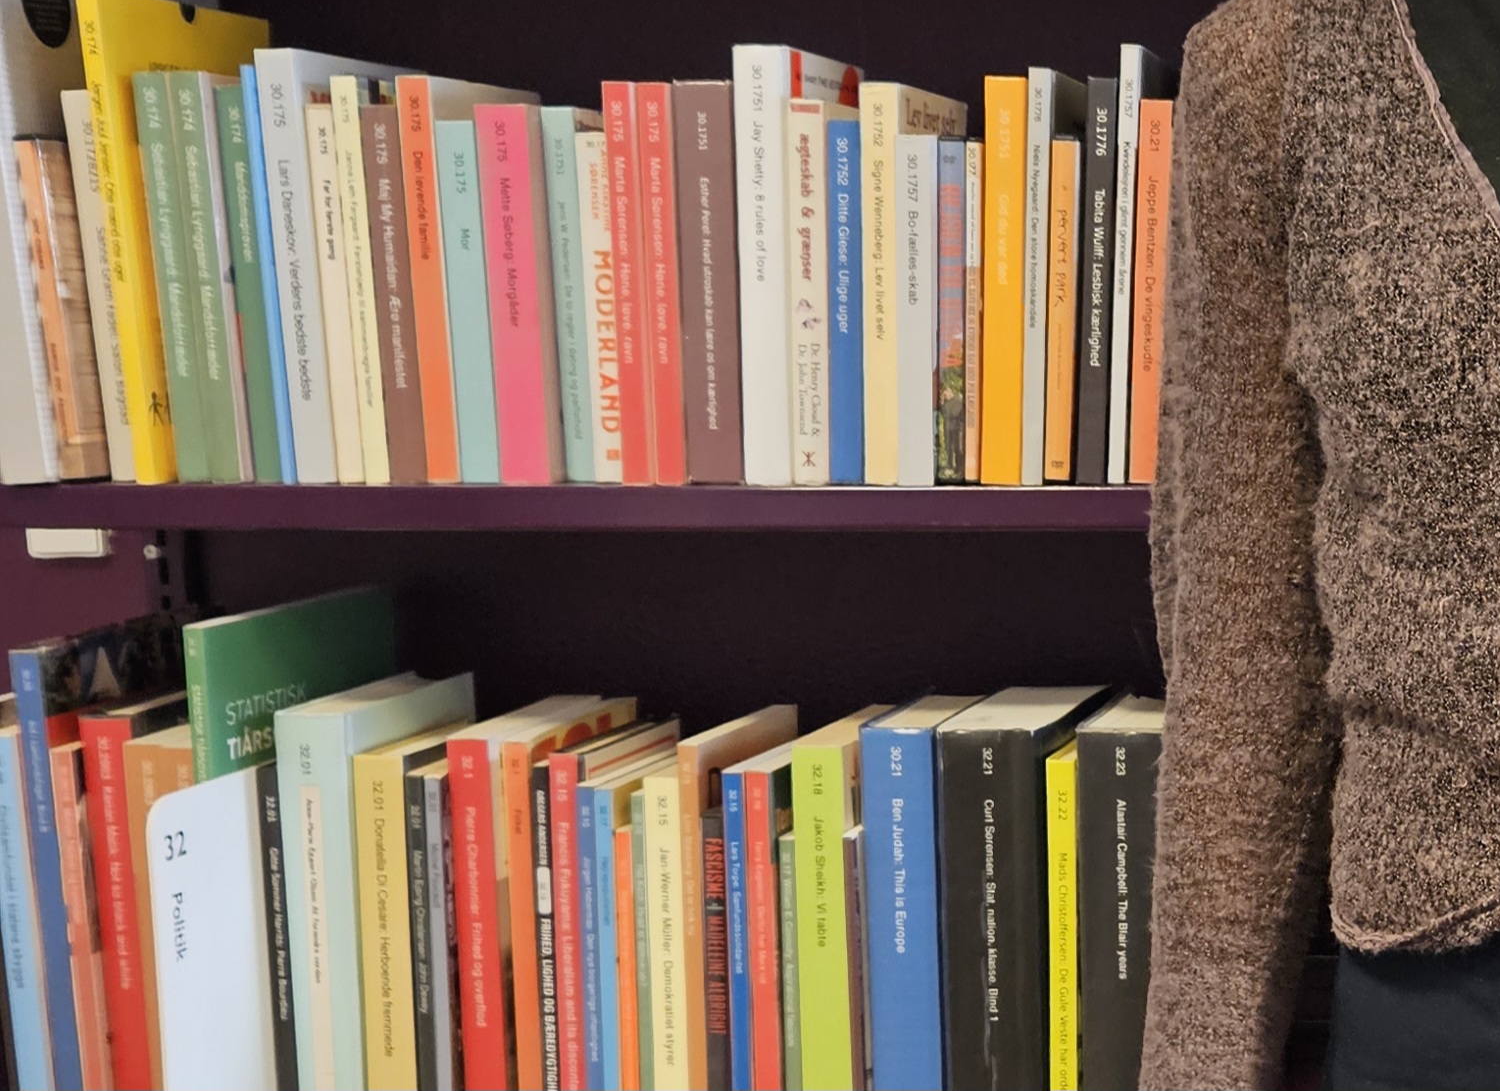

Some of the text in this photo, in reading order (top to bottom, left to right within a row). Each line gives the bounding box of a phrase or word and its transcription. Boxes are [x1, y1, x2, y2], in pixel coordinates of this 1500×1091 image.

[751, 64, 763, 113] 30.1751
[750, 121, 764, 143] Jay
[796, 133, 814, 198] ægteskab
[836, 137, 849, 186] 30.1752
[906, 154, 919, 202] 30.1757
[755, 205, 766, 234] rules
[837, 193, 849, 222] Ditte
[755, 237, 767, 251] of
[1086, 107, 1108, 366] 30.1776 Tabita Wulff: Lesbisk kærlighed
[1139, 119, 1161, 371] 30.21 Jeppe Bentzen: De vingeskudte
[756, 254, 768, 282] love
[798, 228, 812, 282] grænser
[835, 270, 850, 302] Ulige
[835, 305, 847, 334] uger
[593, 249, 617, 434] MODERLAND
[891, 746, 902, 777] 30.21
[1116, 747, 1127, 776] 32.23
[812, 764, 824, 795] 32.18
[892, 798, 904, 821] Ben
[1116, 799, 1127, 840] Alastair
[164, 830, 188, 862] 32
[814, 816, 826, 851] Jakob
[894, 869, 906, 894] This
[816, 903, 827, 914] Vi
[895, 897, 907, 907] is
[1118, 900, 1129, 920] The
[171, 892, 187, 963] Politik
[817, 916, 828, 947] tabte
[893, 911, 908, 953] Europe
[1118, 923, 1129, 948] Blair
[1116, 950, 1127, 979] years
